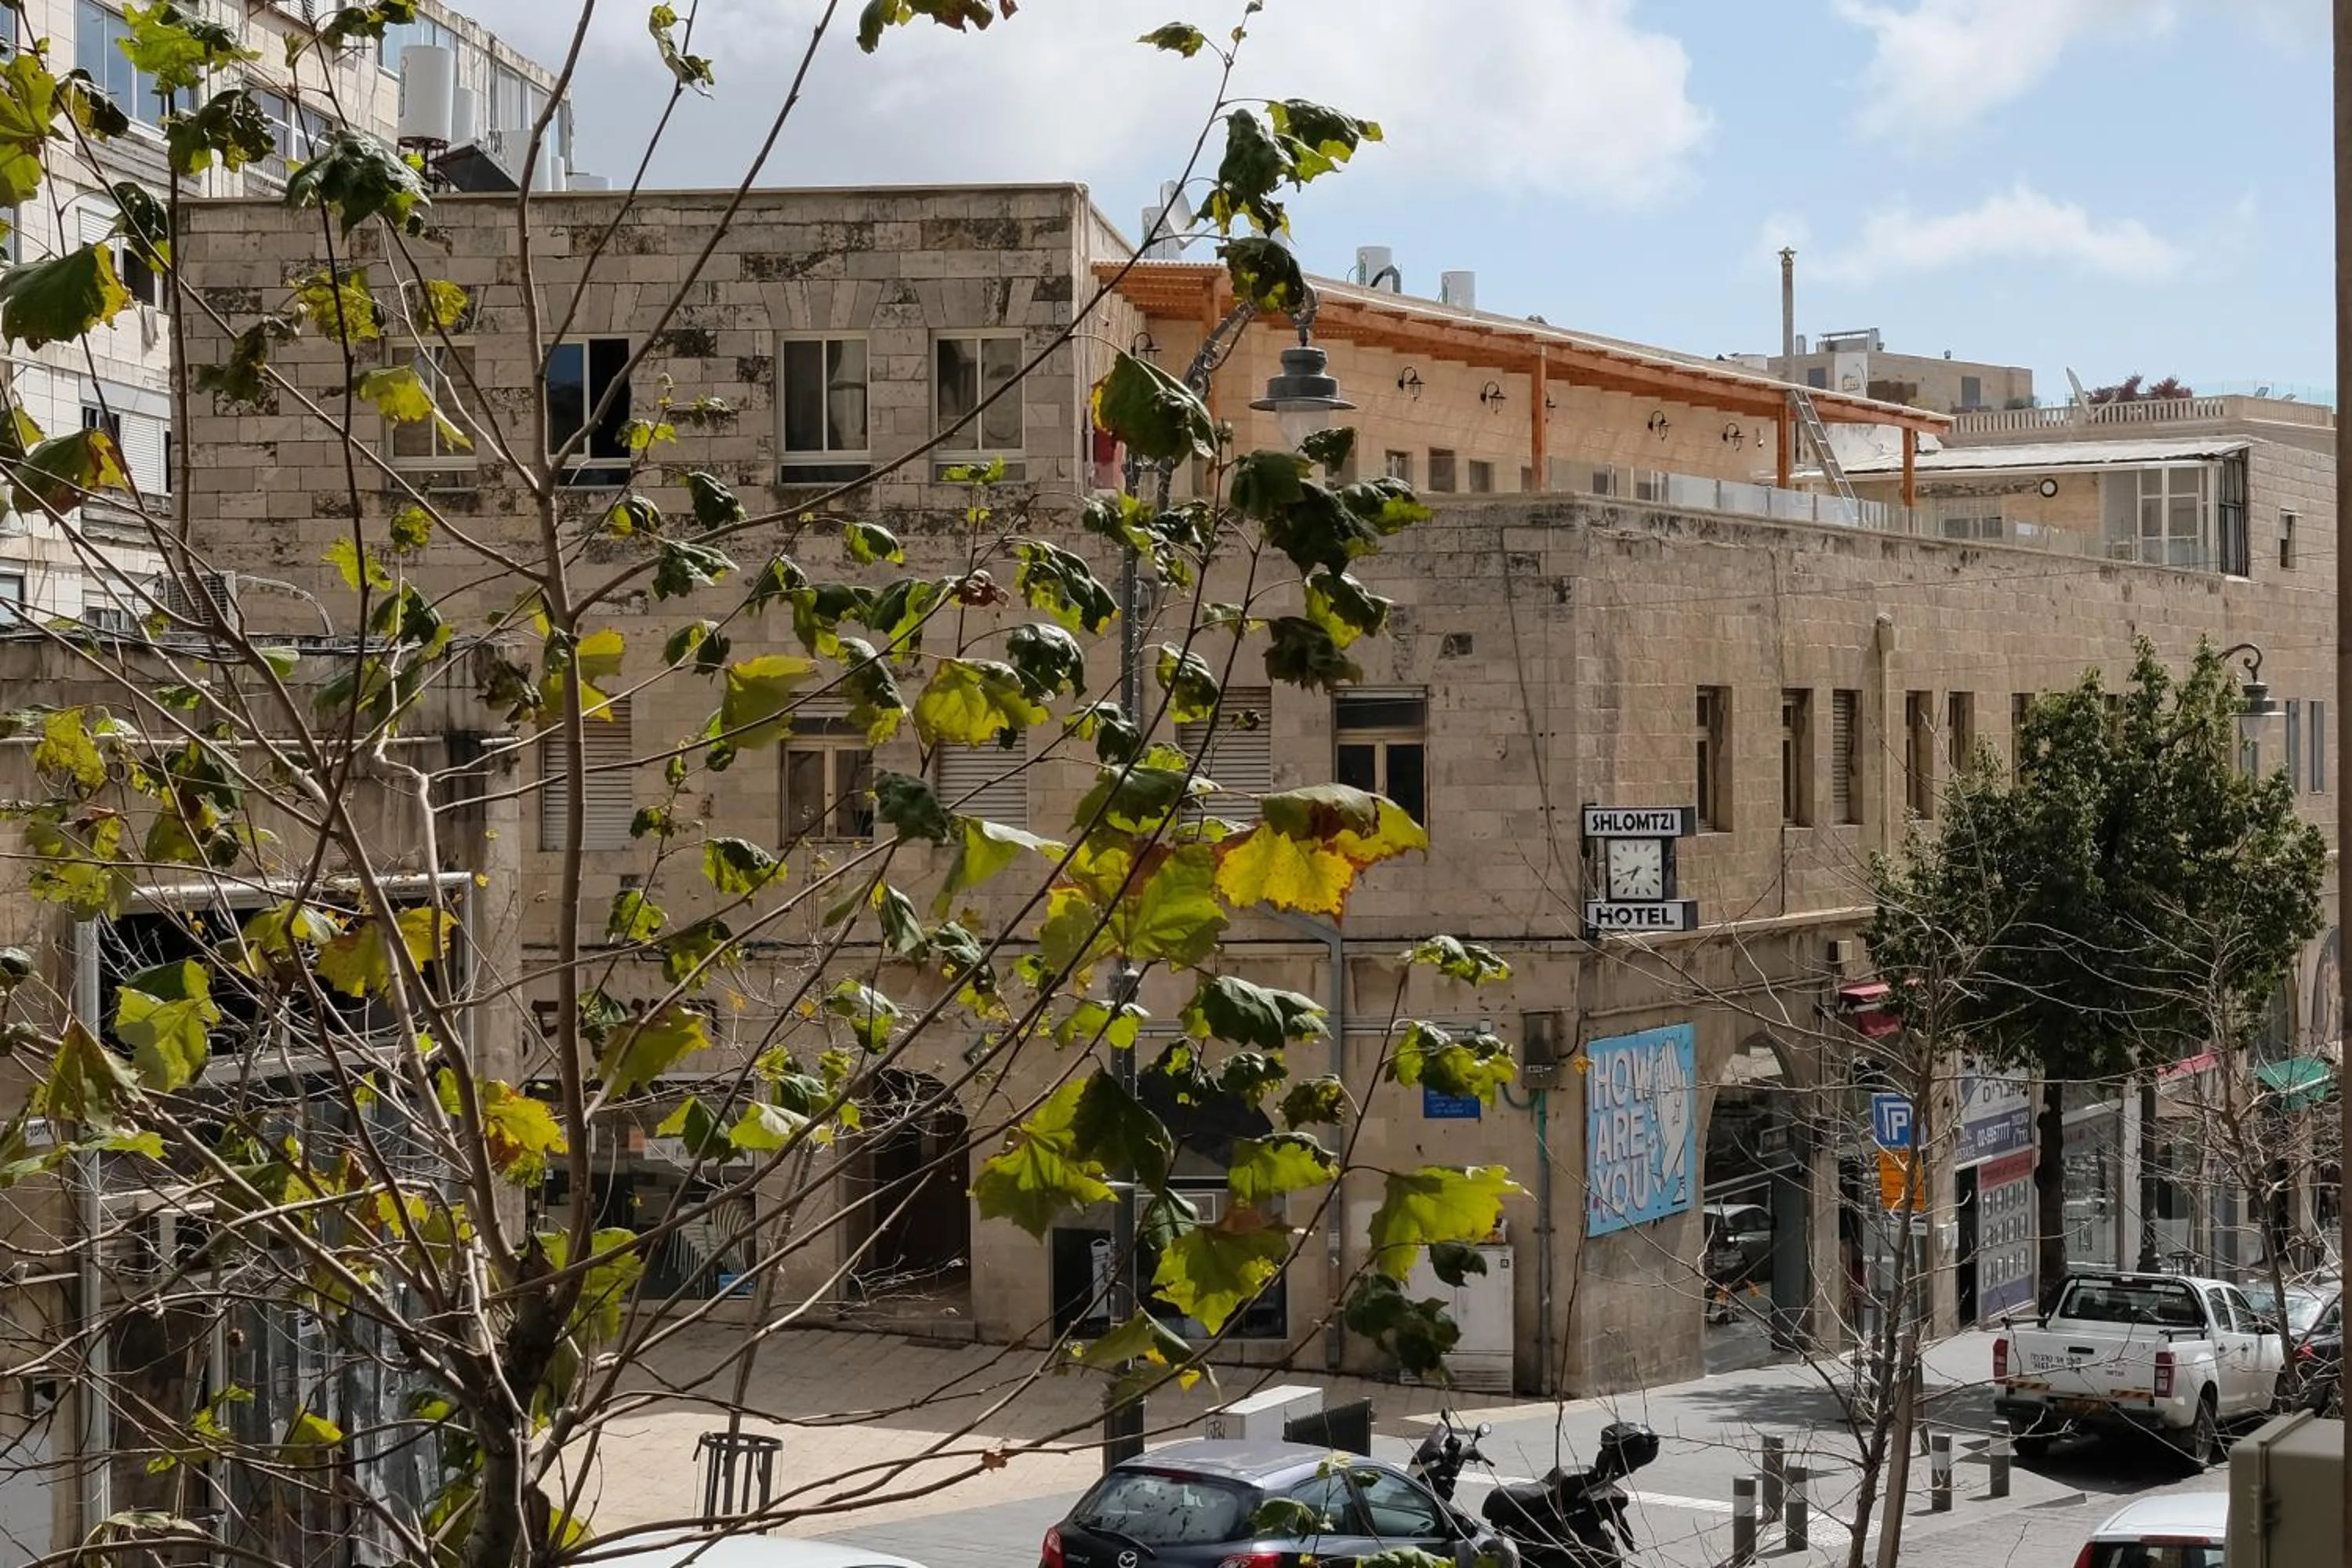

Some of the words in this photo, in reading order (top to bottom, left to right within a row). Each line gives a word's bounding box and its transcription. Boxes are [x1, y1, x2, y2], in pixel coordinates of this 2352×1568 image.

[1592, 813, 1675, 831] SHLOMTZI
[1596, 907, 1675, 925] HOTEL
[1593, 1044, 1656, 1112] HOW
[1595, 1106, 1645, 1167] ARE
[1595, 1155, 1646, 1223] YOU
